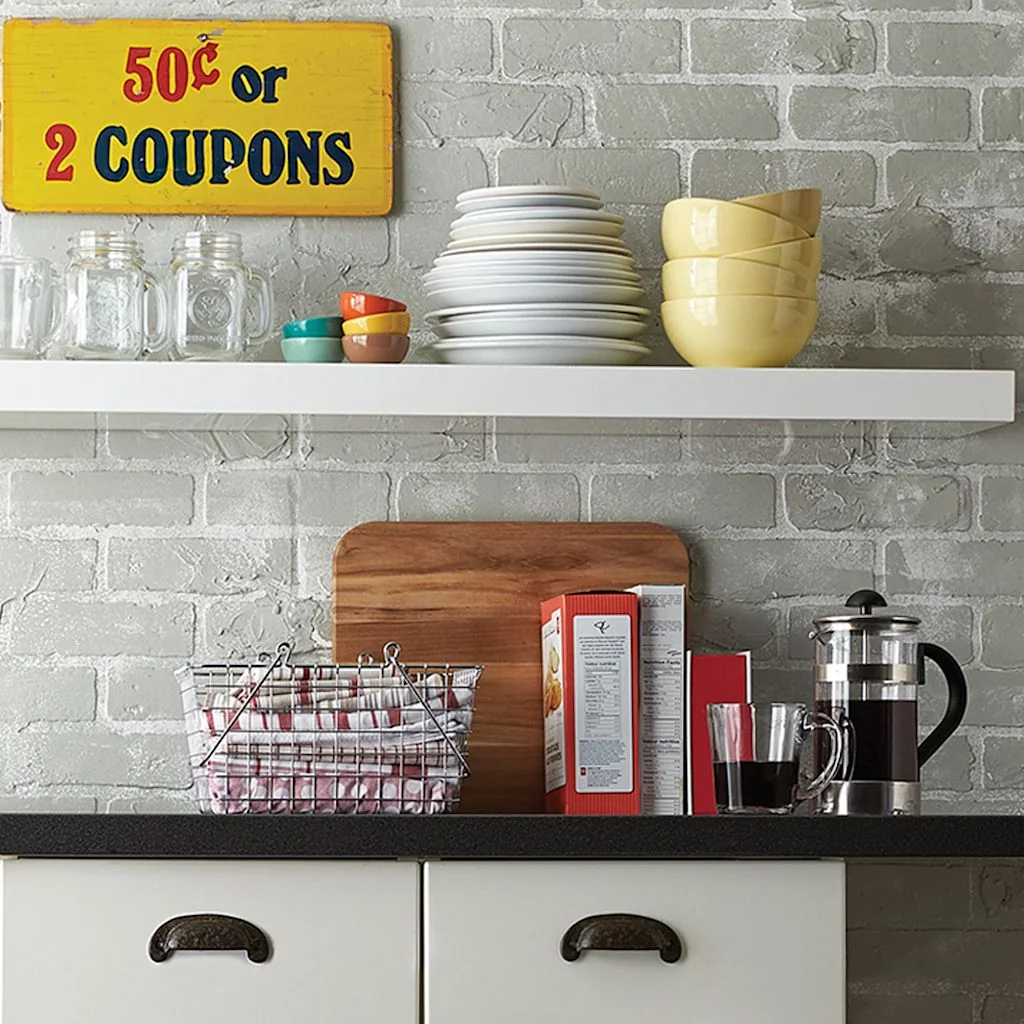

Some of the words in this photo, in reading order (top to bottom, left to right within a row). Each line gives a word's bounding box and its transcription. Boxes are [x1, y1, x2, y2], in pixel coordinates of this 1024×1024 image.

[122, 42, 221, 103] 50¢
[231, 64, 288, 104] or
[44, 123, 77, 182] 2
[93, 125, 355, 186] COUPONS
